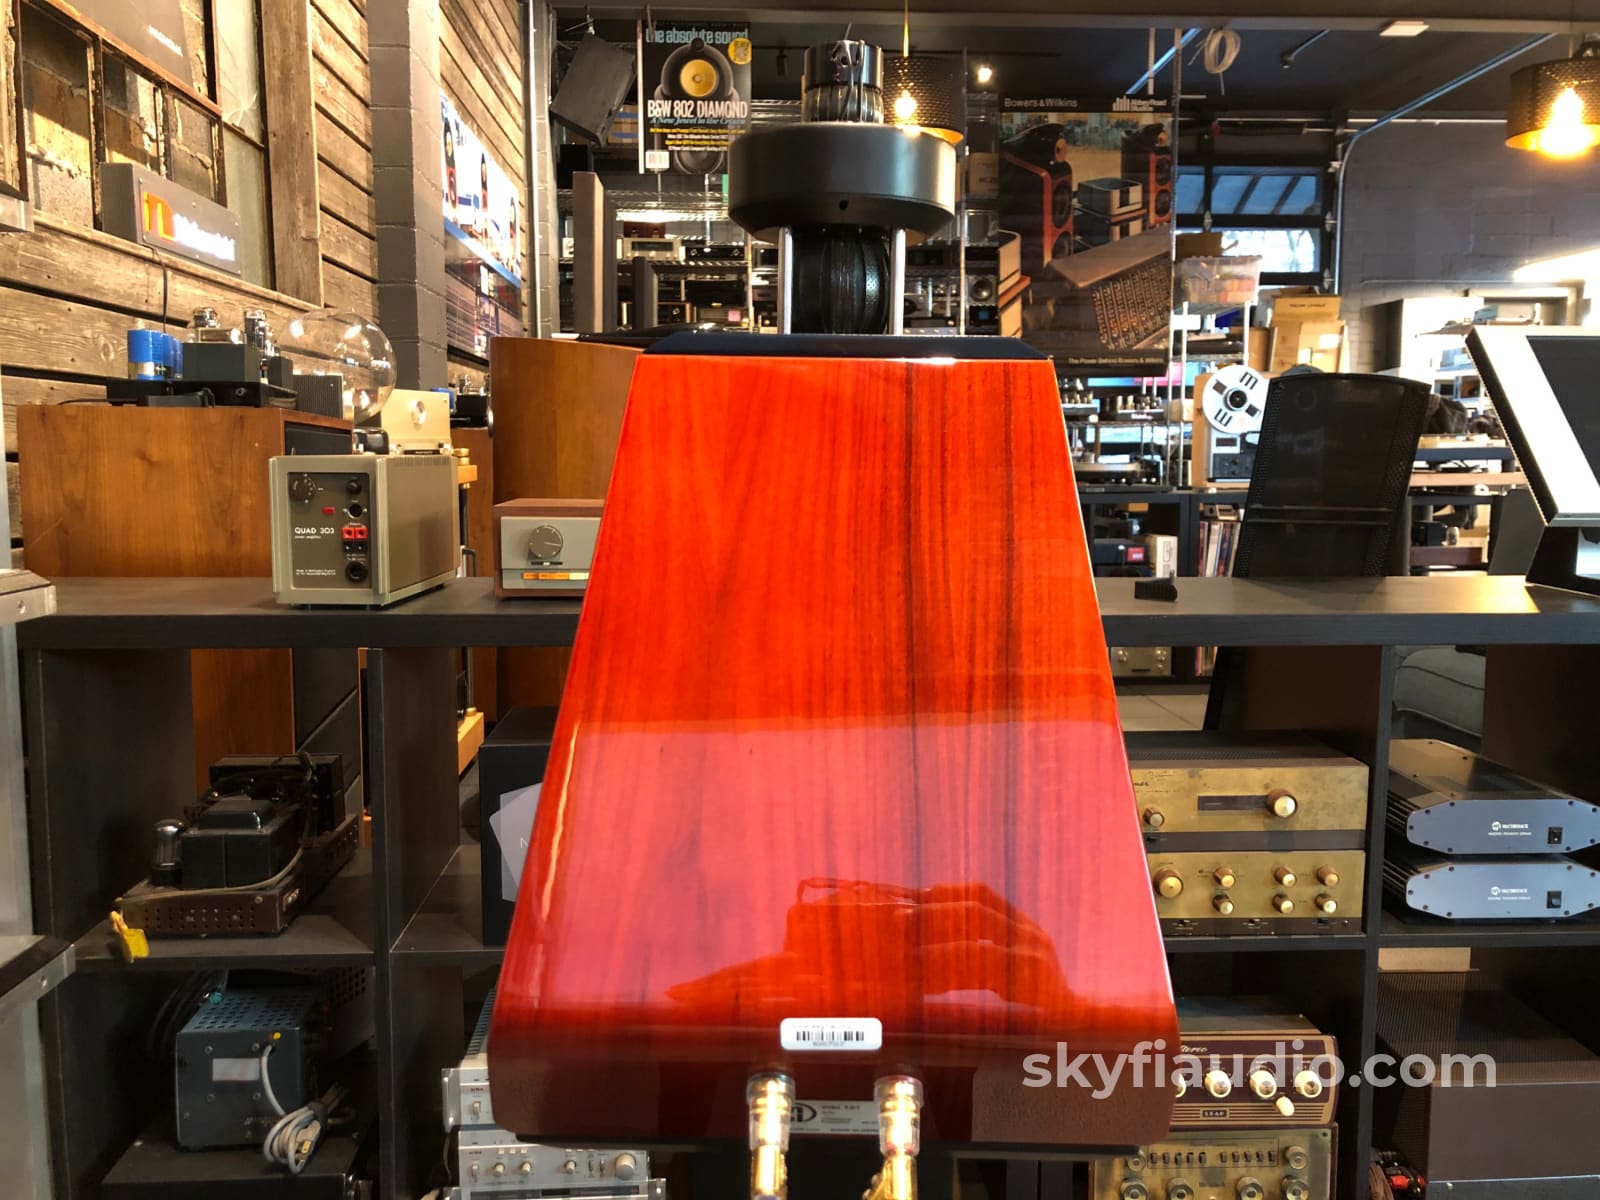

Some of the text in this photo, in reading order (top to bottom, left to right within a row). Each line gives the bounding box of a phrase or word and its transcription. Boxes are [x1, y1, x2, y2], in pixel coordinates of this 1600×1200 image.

[647, 100, 748, 118] B&W 802 DIAMOND
[1004, 98, 1038, 107] Bowers
[1045, 98, 1078, 107] Wilkins
